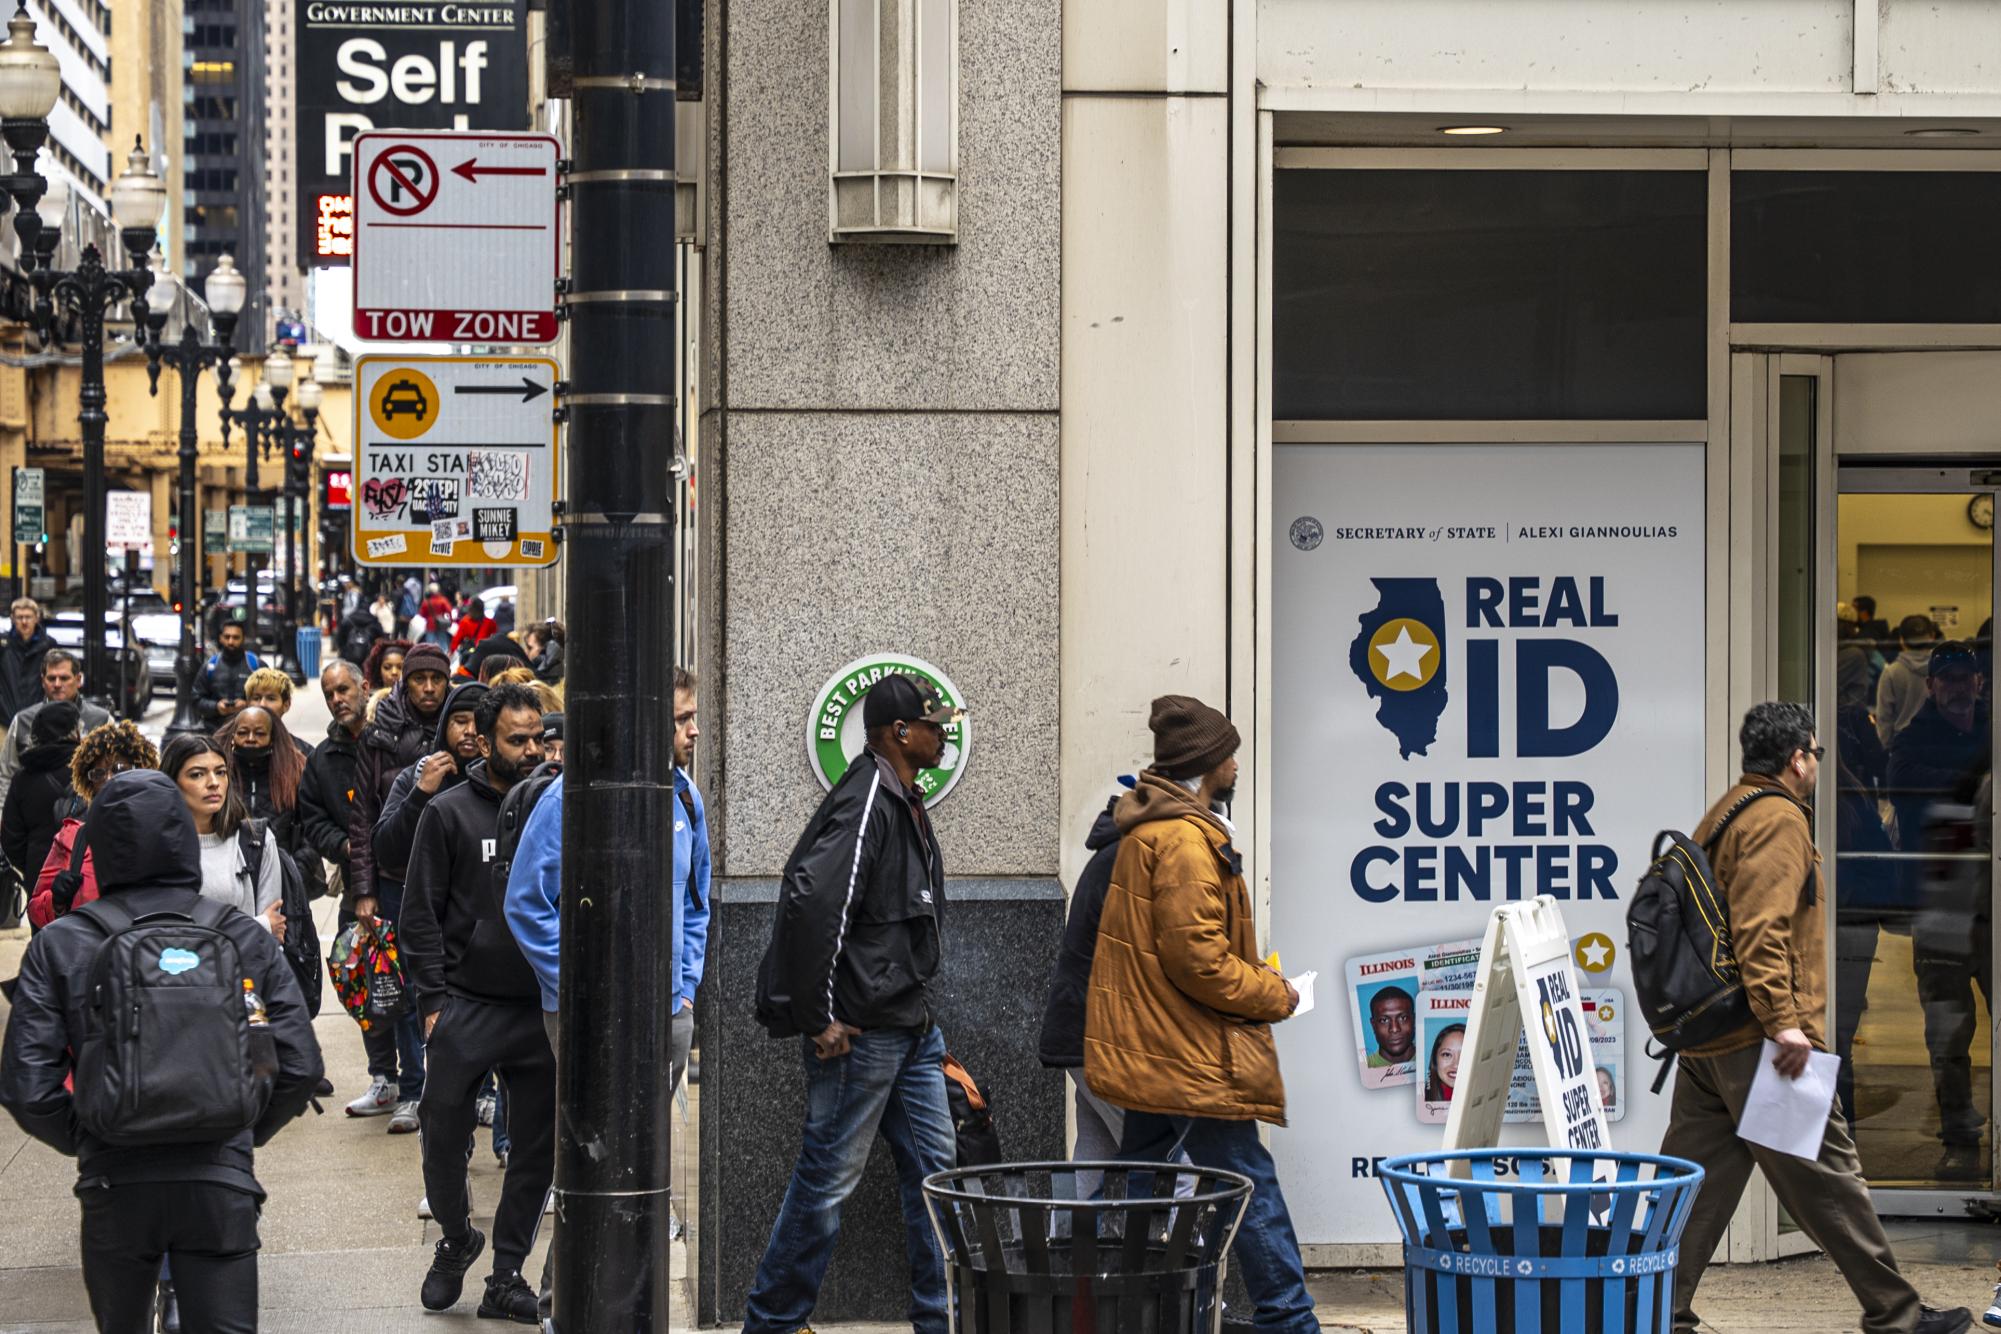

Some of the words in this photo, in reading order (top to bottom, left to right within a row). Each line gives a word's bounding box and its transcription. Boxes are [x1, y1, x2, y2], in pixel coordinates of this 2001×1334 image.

[307, 3, 434, 22] GOVERNMENT
[441, 5, 514, 23] CENTER
[336, 38, 488, 104] Self
[366, 311, 433, 337] TOW
[453, 313, 540, 339] ZONE
[368, 453, 413, 473] TAXI
[427, 453, 469, 473] STA
[478, 509, 511, 523] SUNNIE
[480, 523, 510, 537] MIKEY
[1336, 527, 1425, 539] SECRETARY
[1429, 527, 1442, 542] of
[1447, 527, 1496, 539] STATE
[1518, 527, 1563, 538] ALEXI
[1569, 526, 1678, 538] GIANNOULIAS
[1466, 576, 1619, 628] REAL
[1466, 639, 1619, 758] ID
[820, 691, 849, 740] BEST
[1373, 781, 1596, 839] SUPER
[1350, 844, 1619, 903] CENTER
[1360, 958, 1415, 976] ILLINOIS
[1431, 954, 1480, 968] IDENTIFICAT
[1548, 970, 1570, 1005] REAL
[1430, 999, 1471, 1010] ILLINO
[1556, 1007, 1583, 1079] ID
[1562, 1084, 1592, 1124] SUPER
[1568, 1117, 1601, 1149] CENTER
[1456, 1256, 1510, 1275] RECYCLE
[1629, 1254, 1666, 1274] RECYCLE
